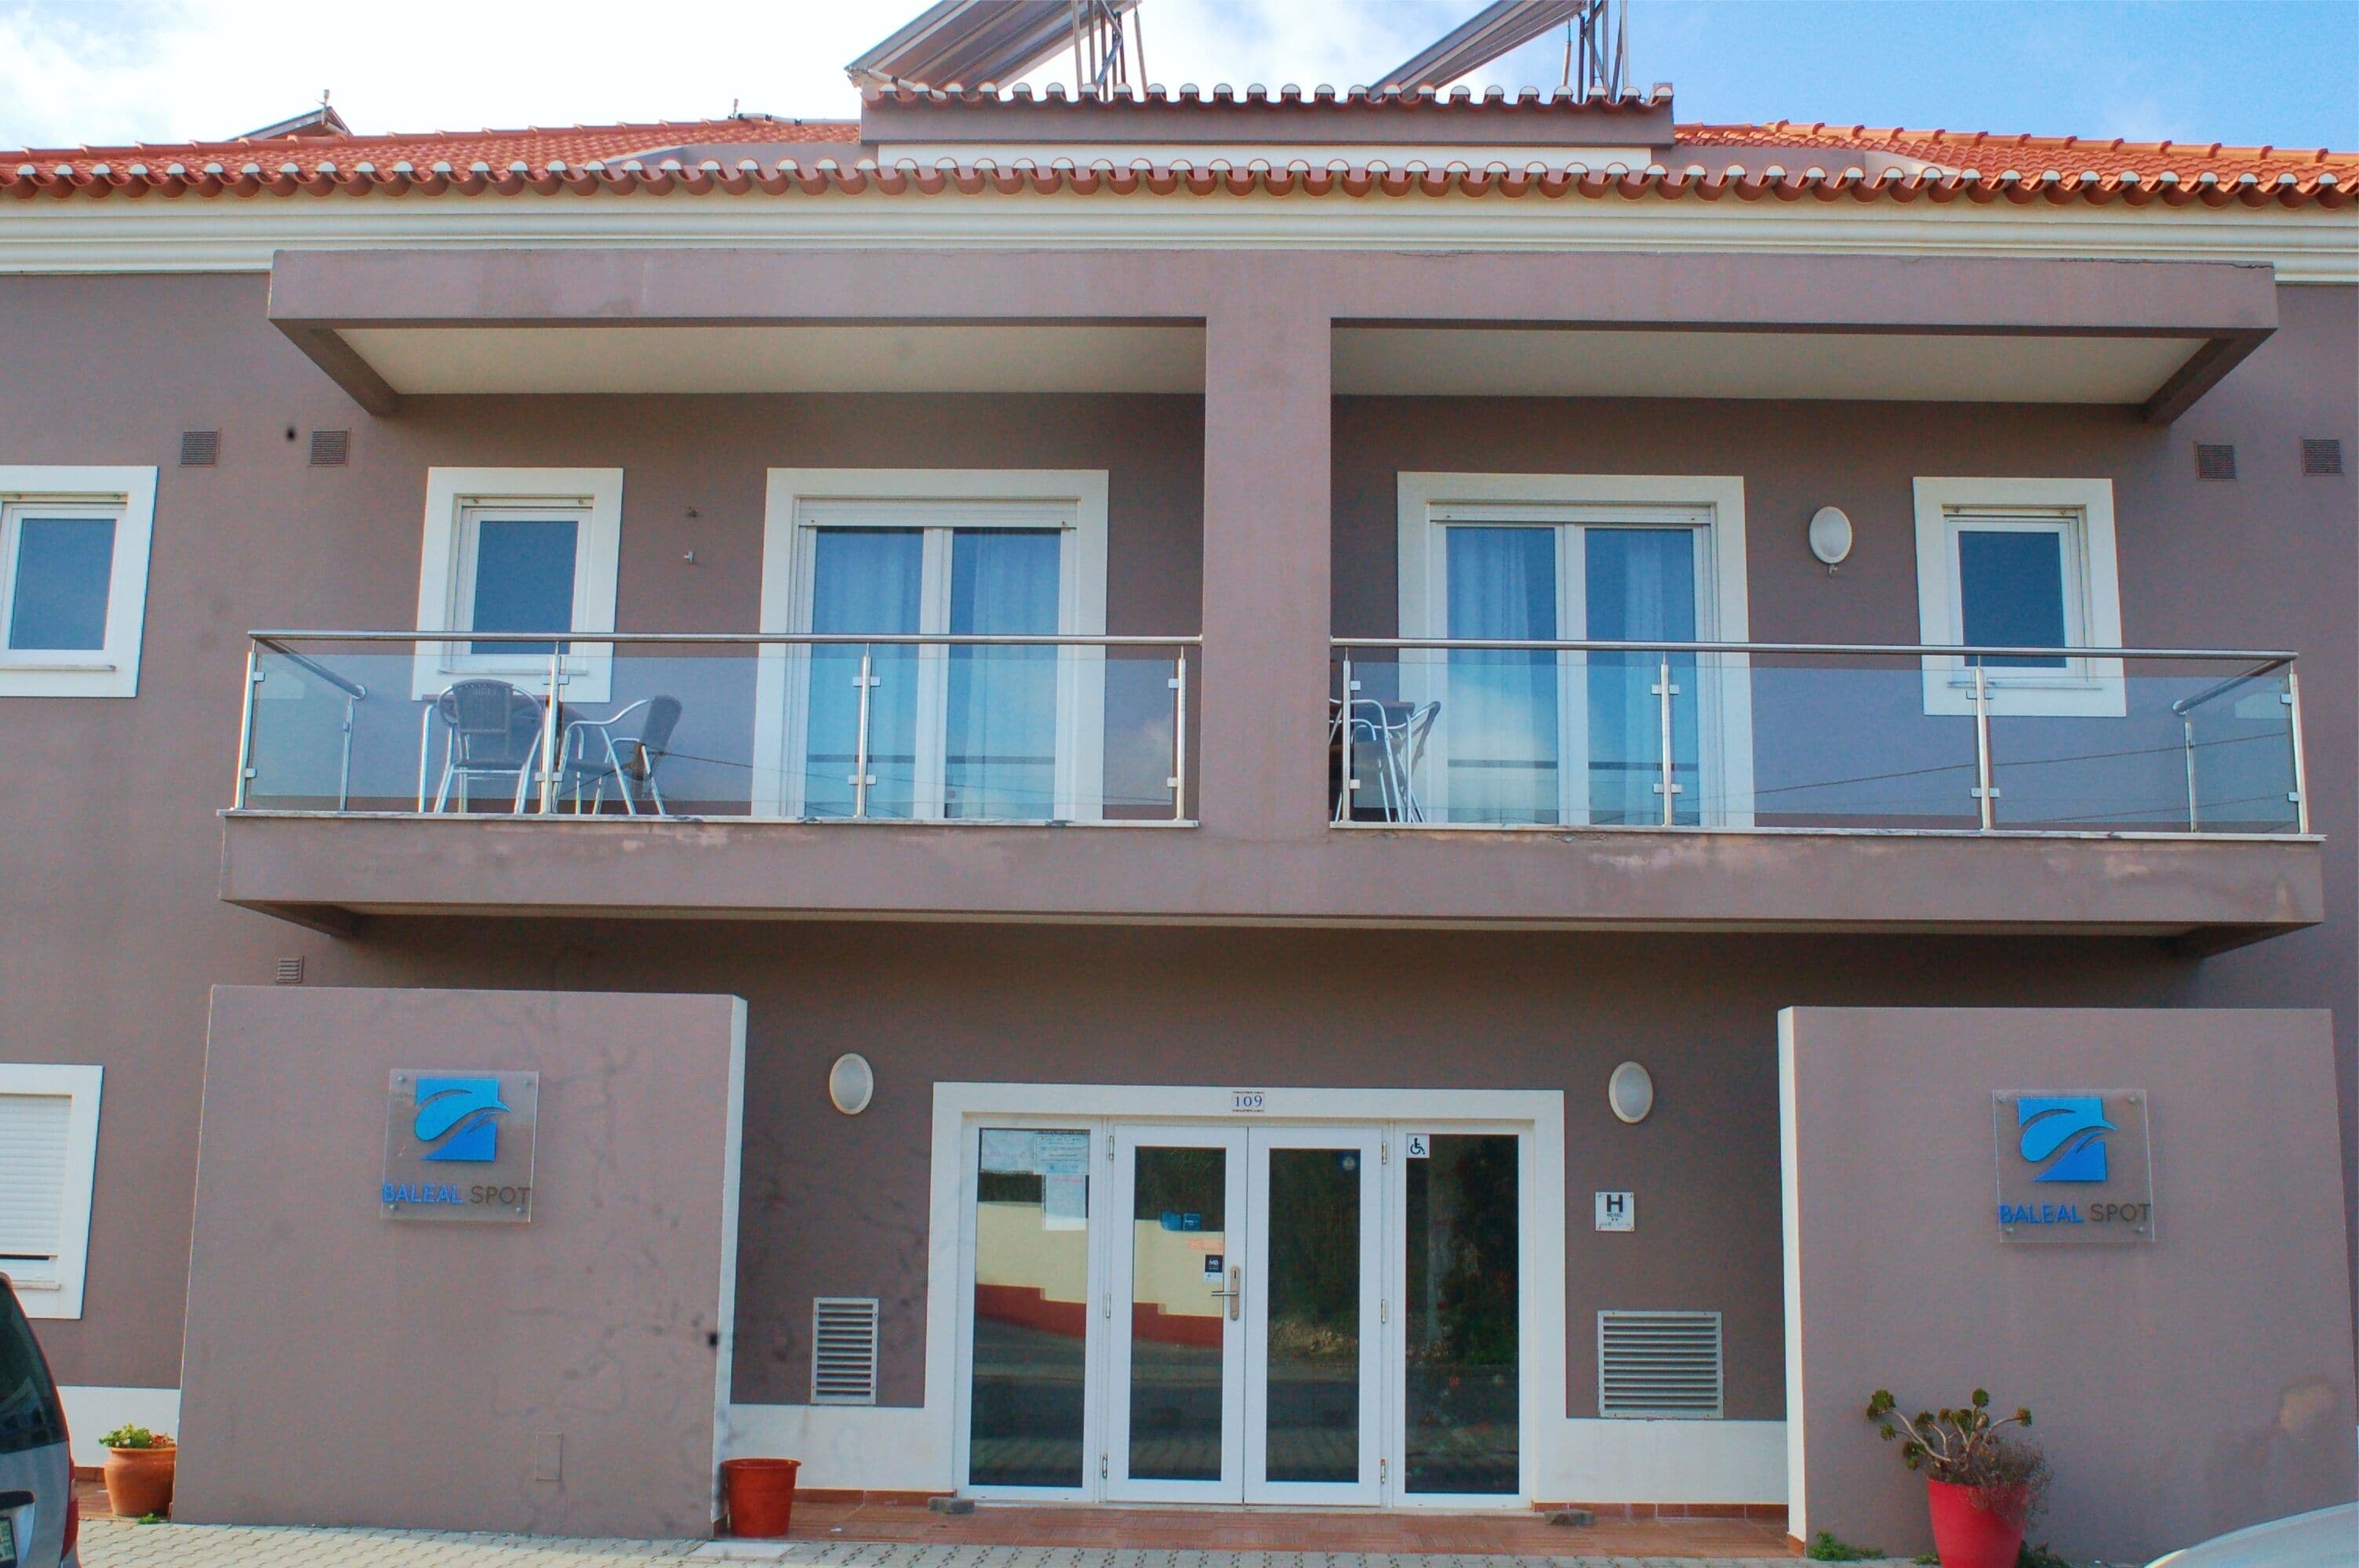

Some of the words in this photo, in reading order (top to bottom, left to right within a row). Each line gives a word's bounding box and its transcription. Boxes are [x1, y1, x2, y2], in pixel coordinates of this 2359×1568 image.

[1235, 1094, 1263, 1107] 109
[382, 1182, 463, 1204] BALEAL
[471, 1185, 531, 1204] SPOT
[1606, 1193, 1623, 1213] H
[1999, 1203, 2084, 1224] BALEAL
[2090, 1203, 2151, 1222] SPOT
